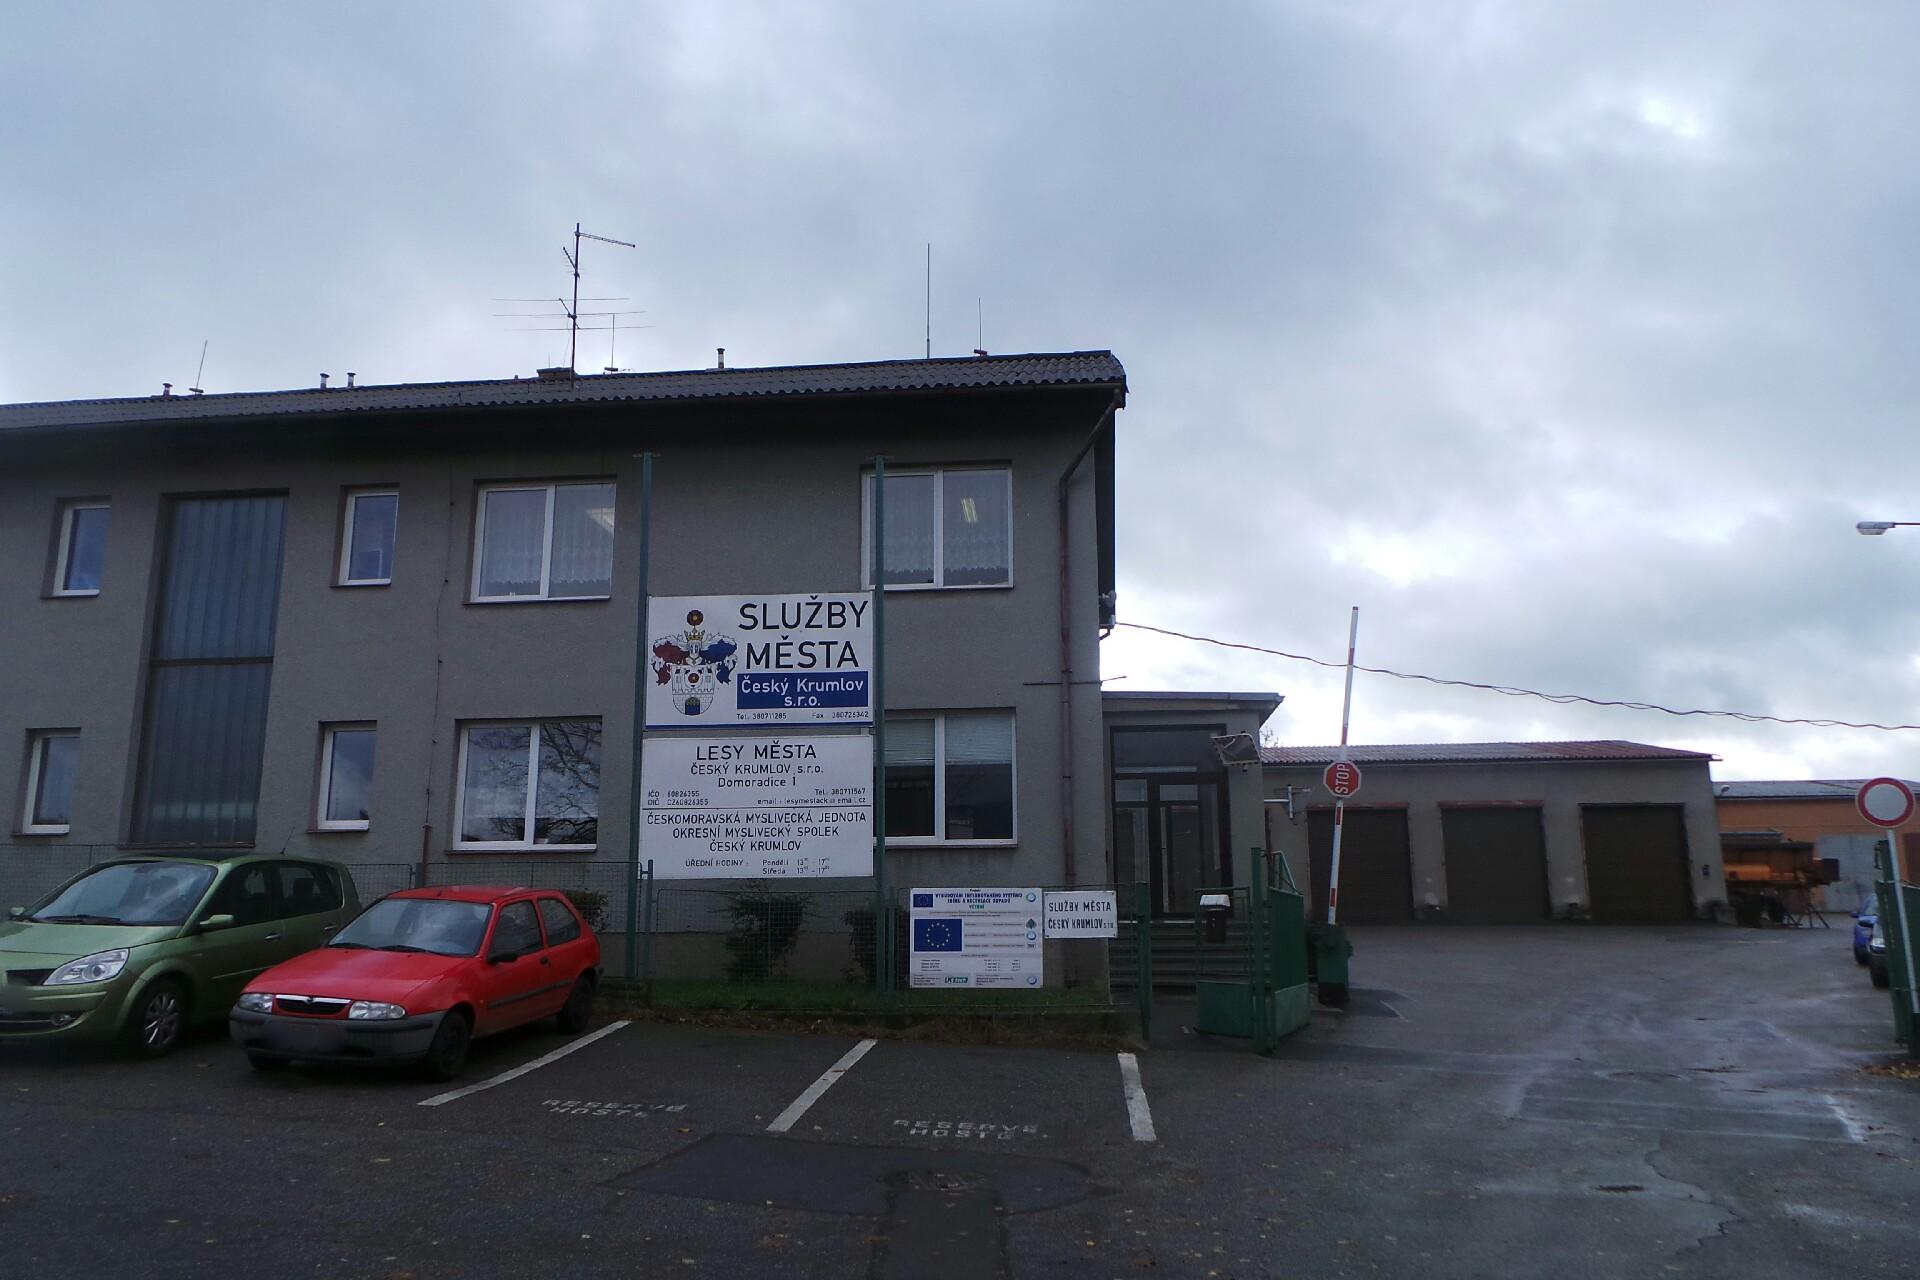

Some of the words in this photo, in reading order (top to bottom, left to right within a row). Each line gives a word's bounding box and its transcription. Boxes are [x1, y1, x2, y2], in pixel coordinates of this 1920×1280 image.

[738, 595, 869, 630] SLUŽBY
[746, 635, 859, 669] MĚSTA
[741, 675, 789, 696] Český
[796, 678, 864, 693] Krumlov
[784, 695, 821, 707] s.r.o.
[752, 712, 787, 720] 380711285
[696, 745, 744, 761] LESY
[754, 740, 817, 760] MĚSTA
[690, 761, 729, 775] ČESKÝ
[735, 763, 791, 775] KRUMLOV
[797, 764, 824, 775] s.r.o.
[717, 775, 787, 788] Domoradice
[1334, 763, 1350, 794] STOP
[831, 787, 866, 796] 380711567
[647, 811, 741, 825] ČESKOMORAVSKÁ
[746, 810, 813, 824] MYSLIVECKÁ
[818, 811, 867, 823] JEDNOTA
[672, 825, 721, 839] OKRESNÍ
[725, 824, 792, 838] MYSLIVECKÝ
[797, 826, 840, 837] SPOLEK
[709, 838, 746, 852] ČESKÝ
[750, 840, 802, 851] KRUMLOV
[685, 857, 714, 867] ÚŘEDNÍ
[715, 858, 744, 867] HODINY
[1048, 899, 1079, 912] SLUŽBY
[1083, 899, 1112, 912] MĚSTA
[1048, 917, 1069, 929] ČESKÝ
[1071, 918, 1103, 929] KRUMLOV
